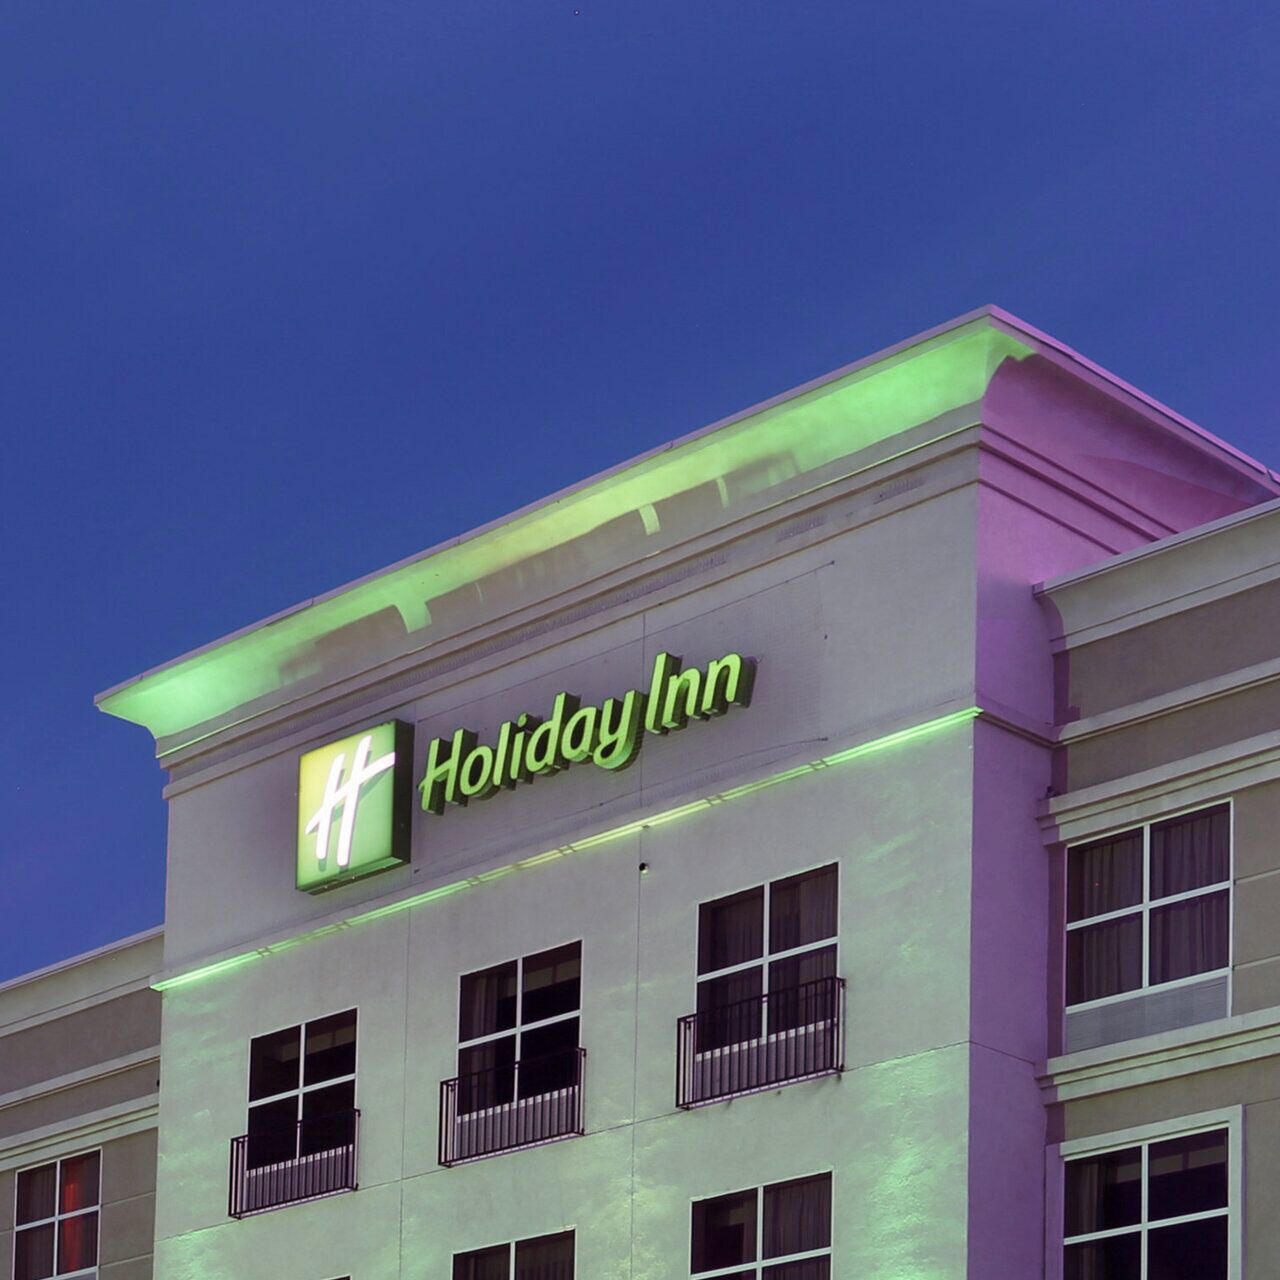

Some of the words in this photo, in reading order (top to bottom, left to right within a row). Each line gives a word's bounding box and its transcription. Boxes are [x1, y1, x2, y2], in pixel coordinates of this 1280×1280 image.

[305, 735, 395, 867] H
[418, 690, 637, 812] Holiday
[645, 652, 743, 732] Inn
